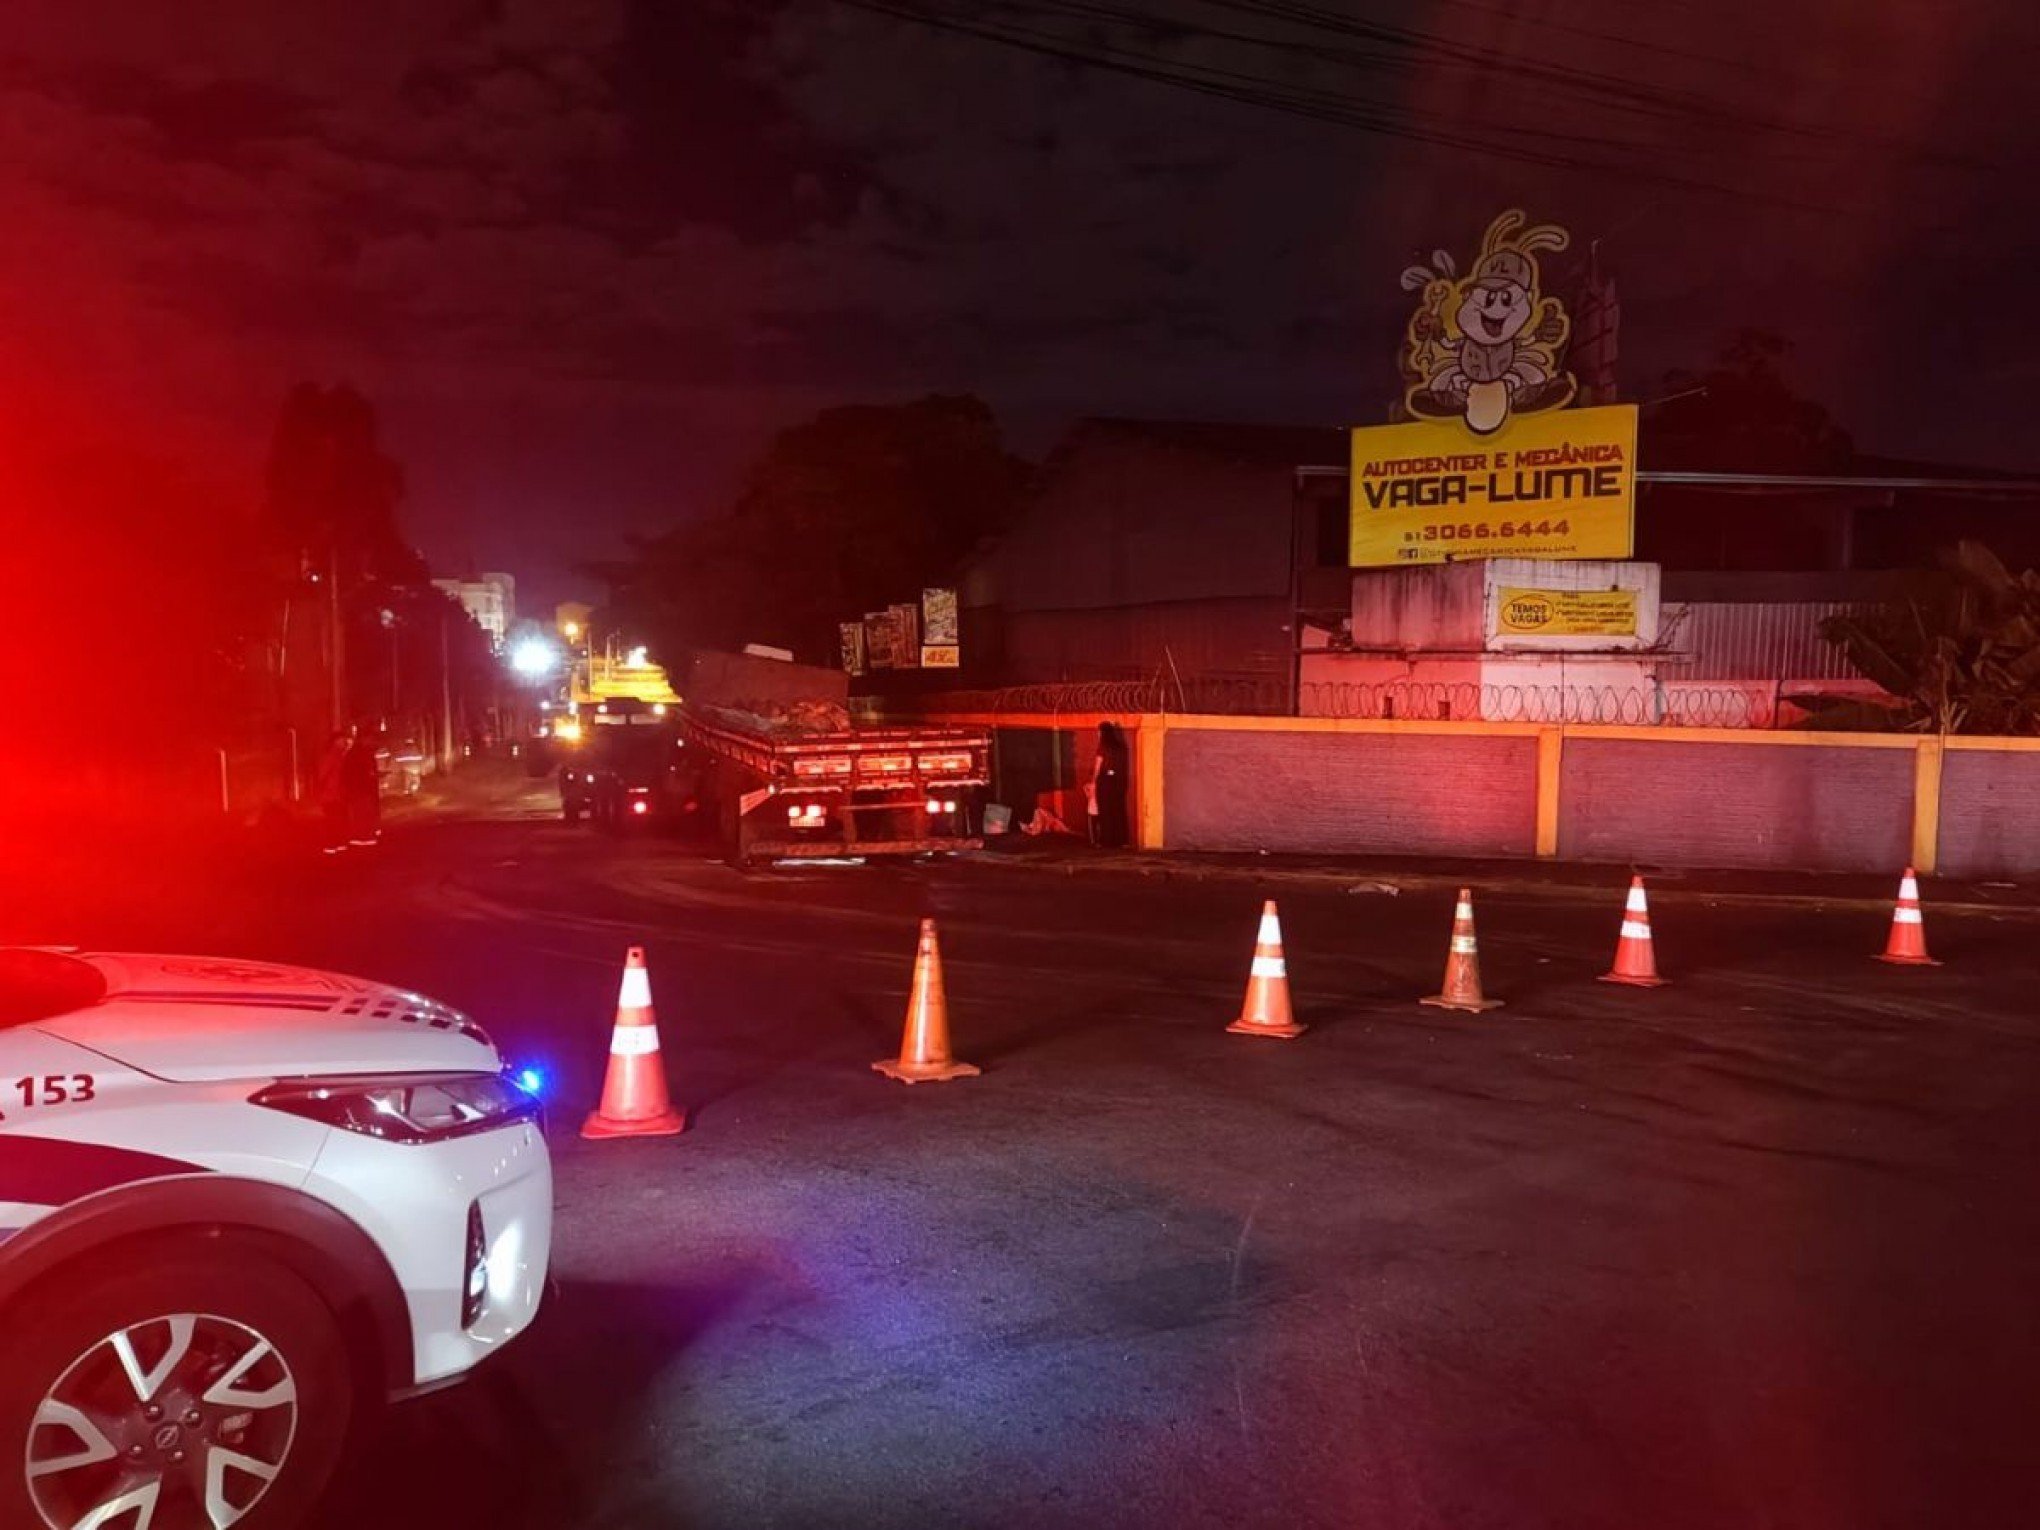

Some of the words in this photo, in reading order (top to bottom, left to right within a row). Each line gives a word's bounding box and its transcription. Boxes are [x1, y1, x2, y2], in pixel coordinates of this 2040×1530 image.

[1363, 454, 1487, 478] AUTOCENTER
[1494, 452, 1508, 469] E
[1515, 442, 1624, 469] MECÂNICA
[1363, 466, 1622, 509] VAGA-LUME
[1423, 519, 1570, 541] 3066.6444
[15, 1074, 95, 1107] 153
